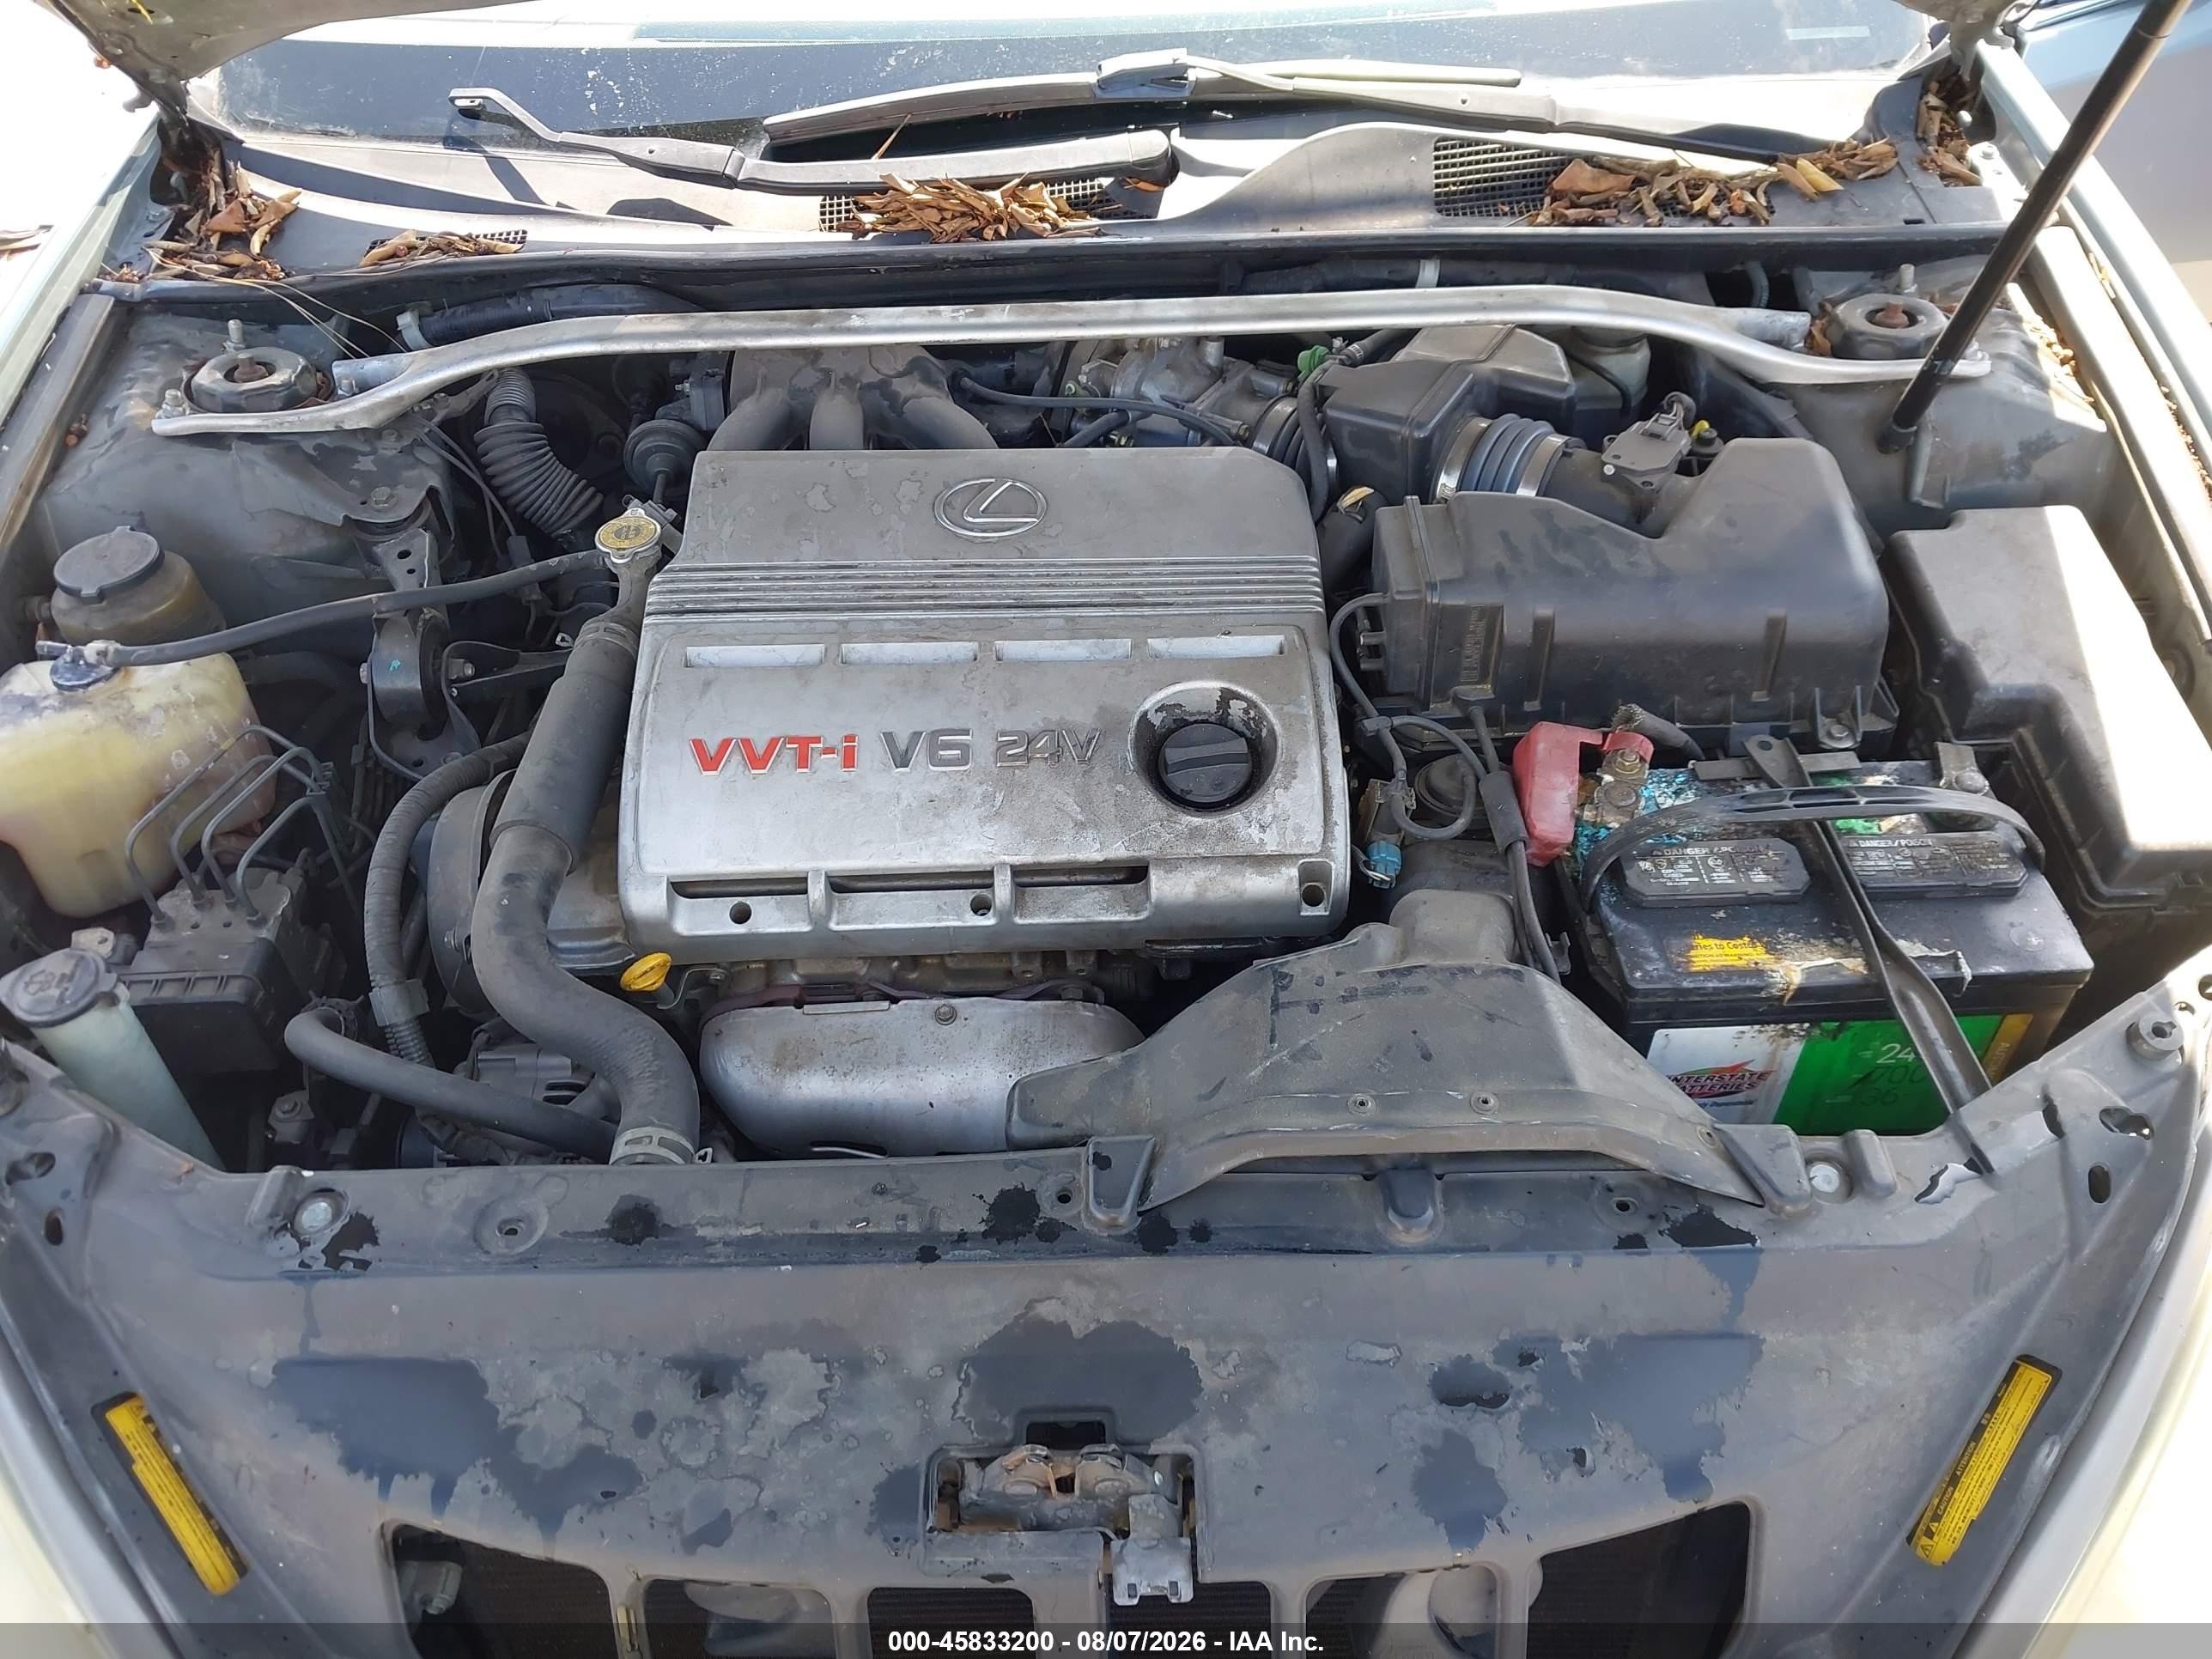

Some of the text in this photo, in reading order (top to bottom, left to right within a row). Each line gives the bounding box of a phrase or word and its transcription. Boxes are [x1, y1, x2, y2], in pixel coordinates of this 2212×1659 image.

[690, 727, 1104, 775] VVT-i V6 24V
[1937, 1486, 1954, 1515] CAUTION
